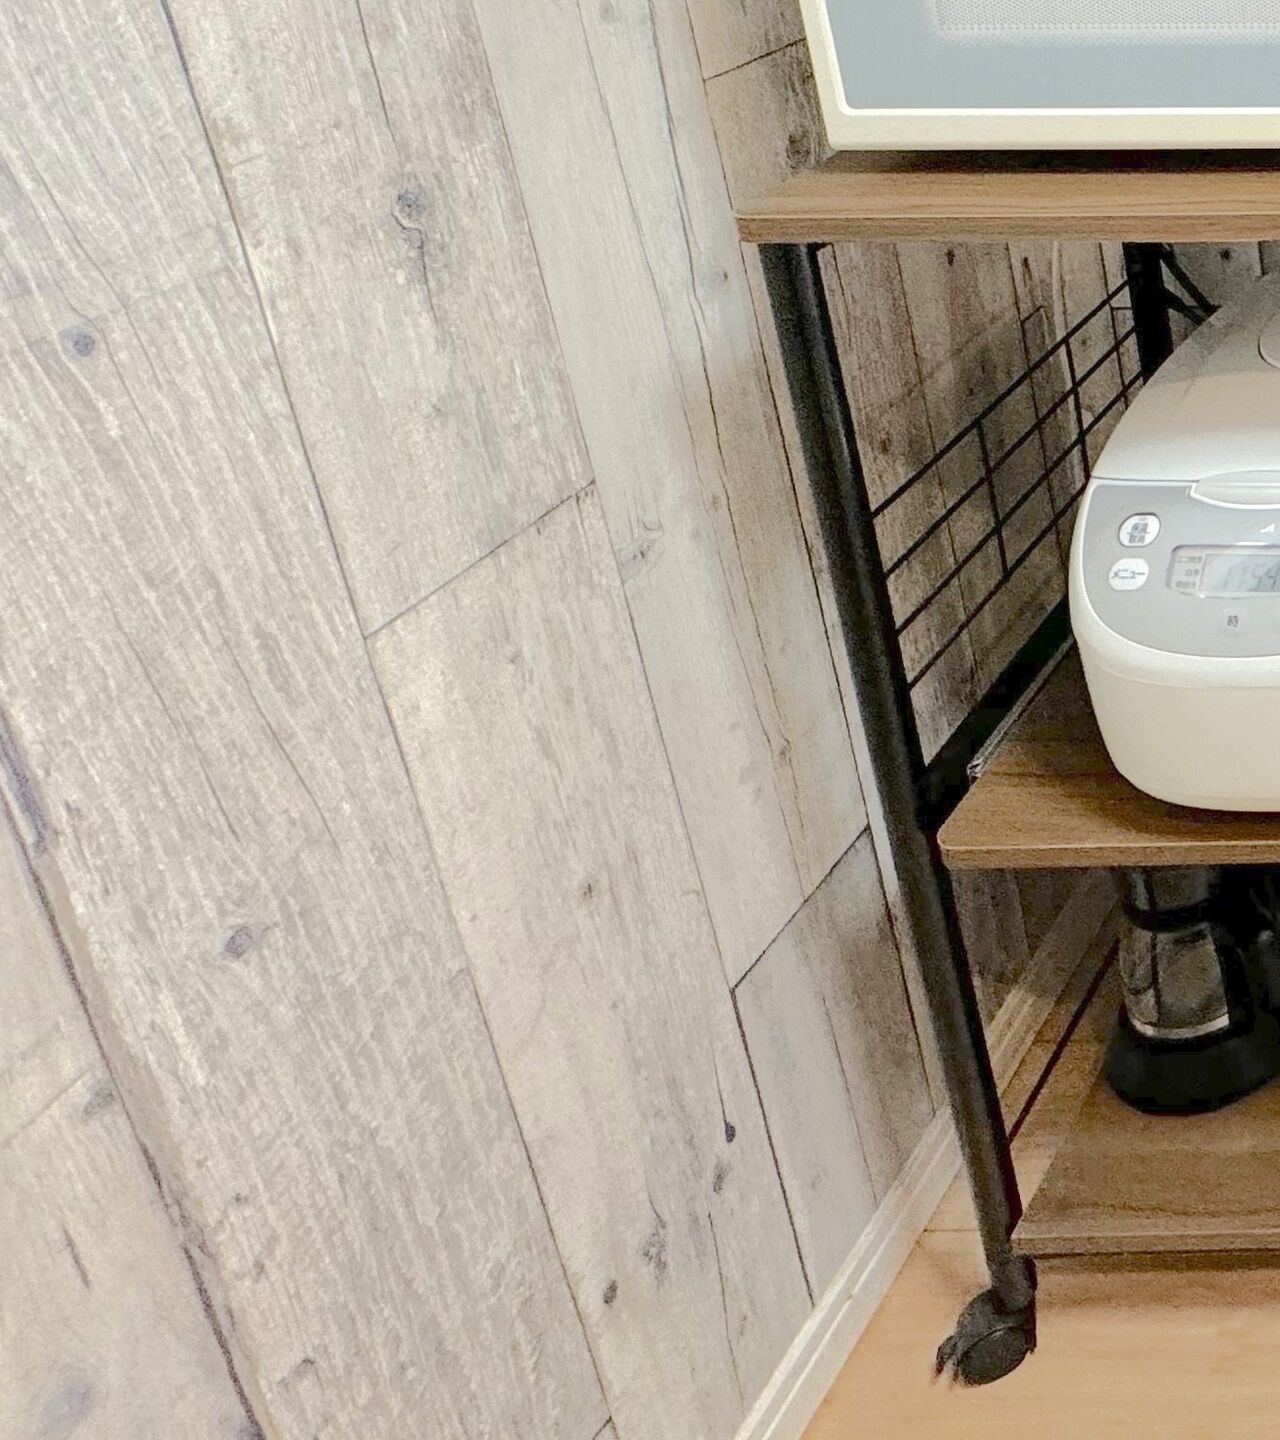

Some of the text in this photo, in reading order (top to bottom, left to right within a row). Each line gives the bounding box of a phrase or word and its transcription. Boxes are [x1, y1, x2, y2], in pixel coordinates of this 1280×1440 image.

[1111, 567, 1147, 580] メニュー
[1226, 614, 1240, 628] 時
